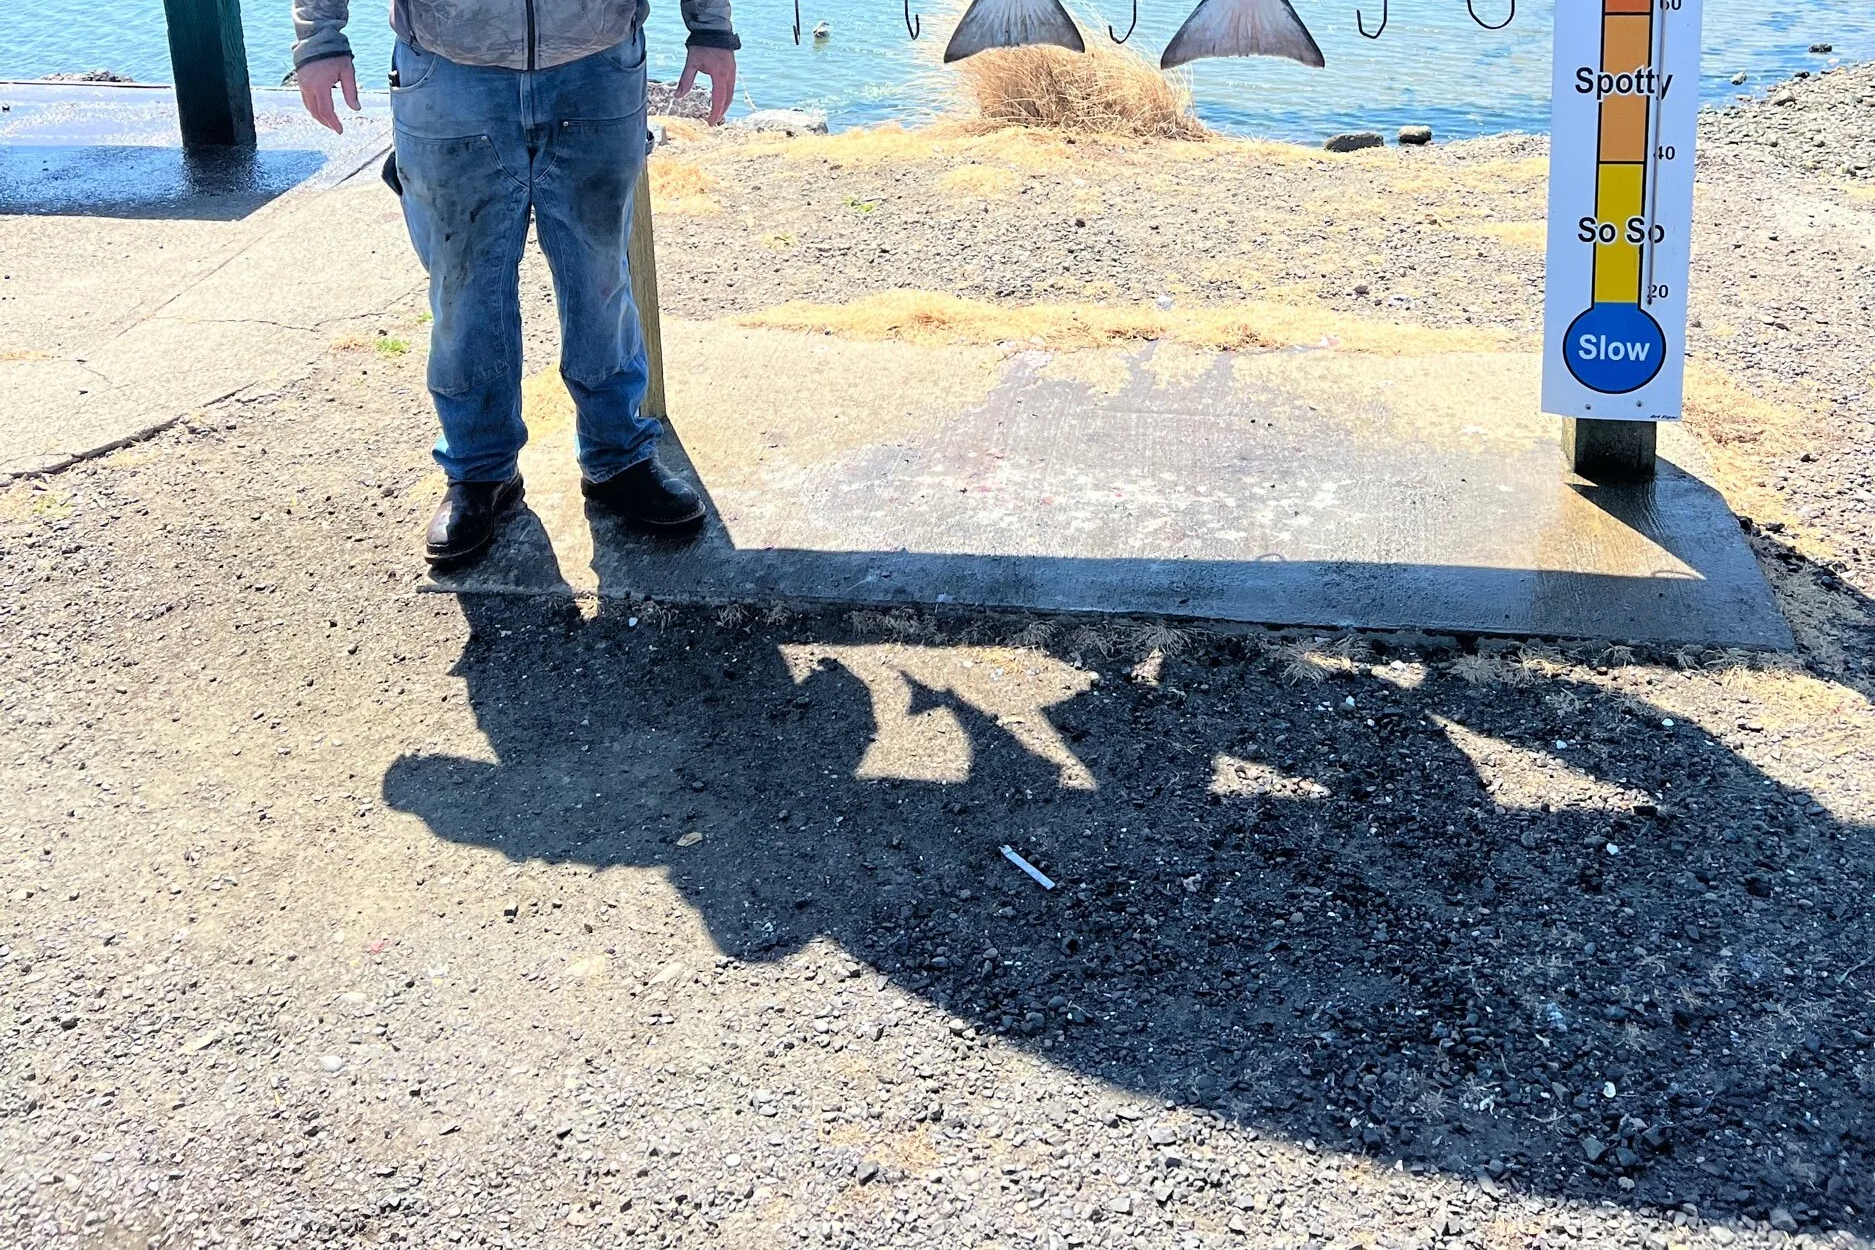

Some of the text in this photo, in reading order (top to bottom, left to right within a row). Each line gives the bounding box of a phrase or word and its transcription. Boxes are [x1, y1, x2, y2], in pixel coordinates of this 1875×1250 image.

[1575, 67, 1673, 101] Spotty
[1653, 145, 1675, 160] 40
[1578, 216, 1665, 243] So So
[1647, 284, 1669, 299] 20
[1578, 333, 1650, 361] Slow
